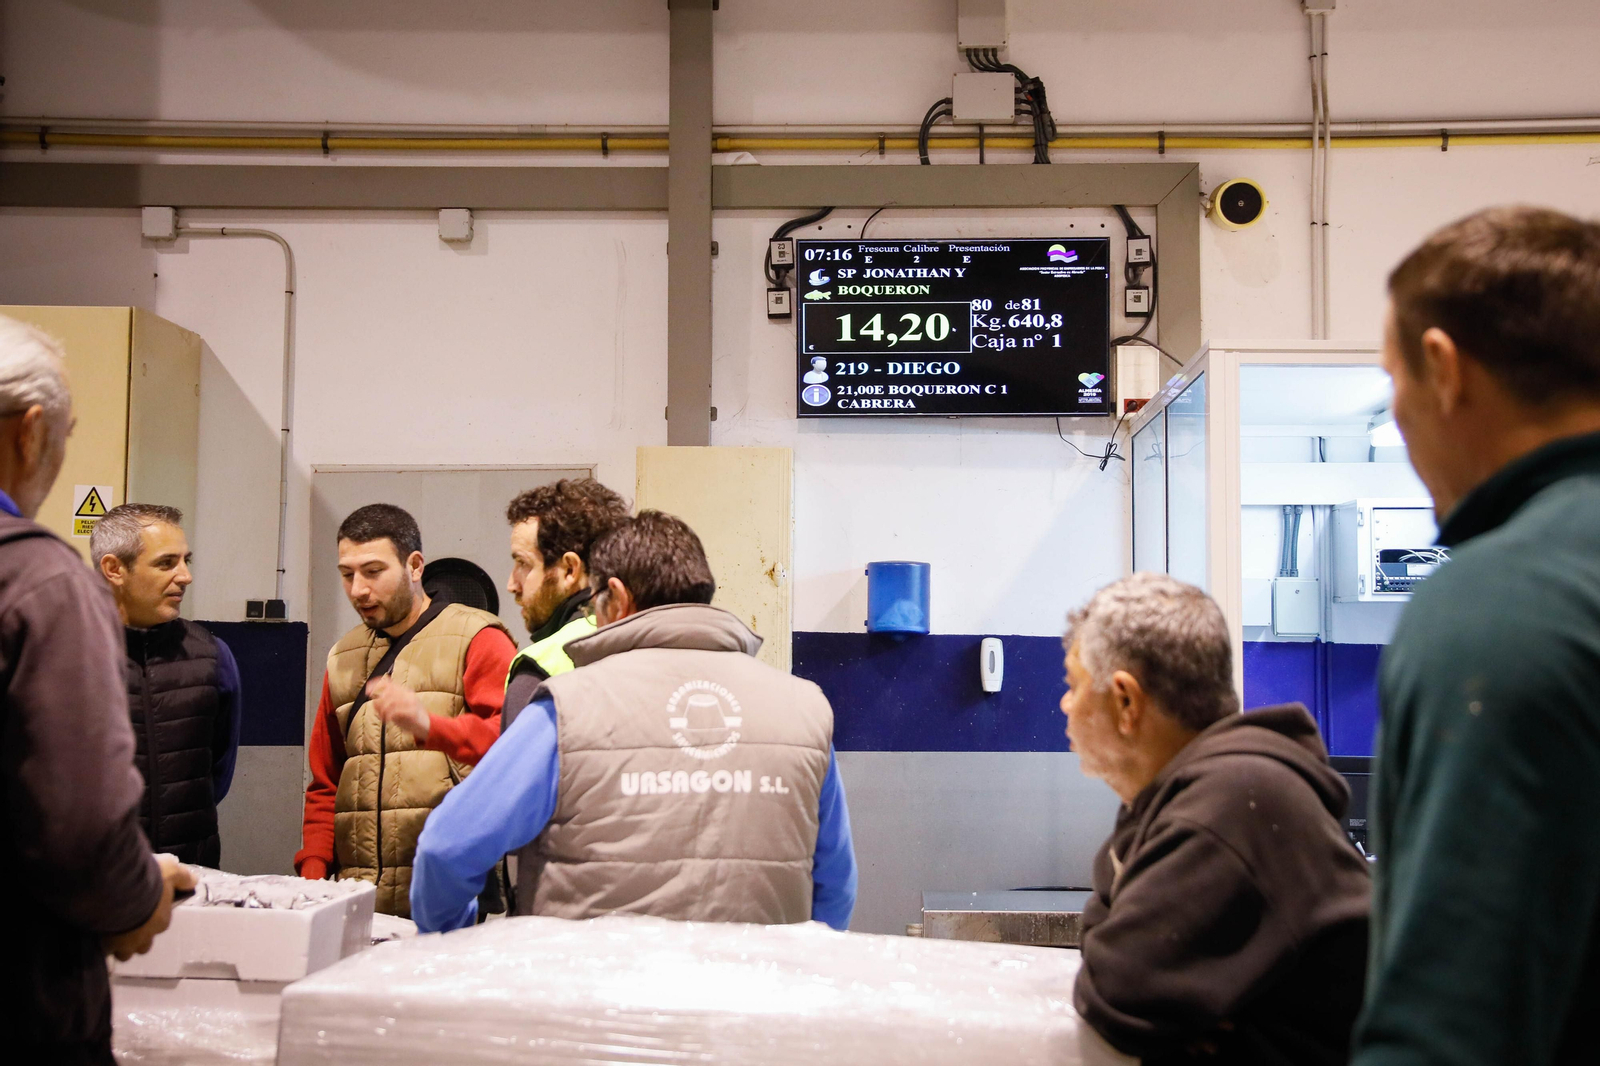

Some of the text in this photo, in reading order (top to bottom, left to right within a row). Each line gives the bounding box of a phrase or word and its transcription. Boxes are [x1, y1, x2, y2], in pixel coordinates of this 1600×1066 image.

[949, 244, 1010, 252] Presentación
[805, 249, 852, 261] 07:16
[838, 268, 966, 278] SP JONATHAN Y
[838, 285, 930, 297] BOQUERON
[972, 299, 1040, 311] 80 de 81
[972, 314, 1062, 331] Kg. 640,8
[836, 313, 949, 347] 14,20
[972, 334, 1016, 351] Caja
[1052, 334, 1061, 347] 1
[836, 362, 868, 375] 219
[887, 362, 960, 374] DIEGO
[837, 385, 1007, 396] 21,00E BOQUERON C 1
[838, 399, 915, 408] CABRERA
[621, 770, 789, 796] URSAGON S.L.
